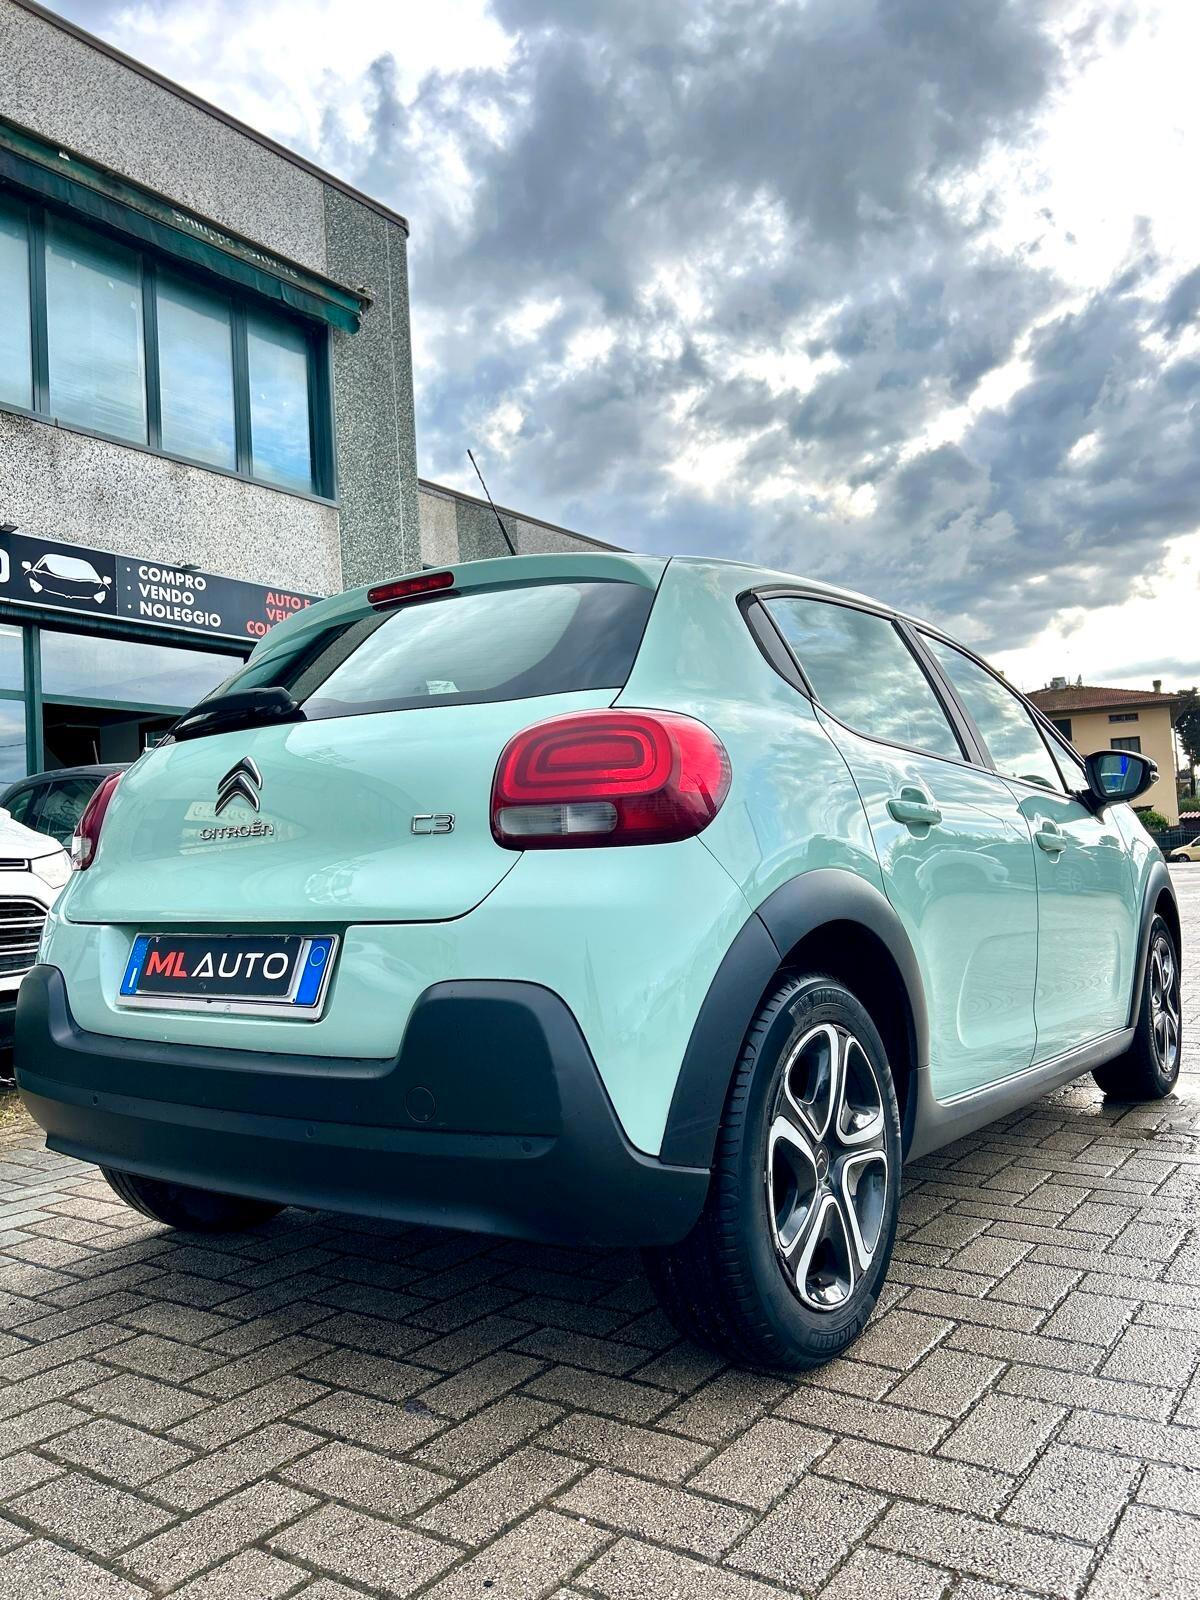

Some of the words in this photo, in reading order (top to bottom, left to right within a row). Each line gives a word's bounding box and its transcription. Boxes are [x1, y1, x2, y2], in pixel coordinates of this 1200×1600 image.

[138, 565, 206, 591] COMPRO
[139, 583, 195, 606] VENDO
[265, 591, 301, 610] AUTO
[139, 601, 221, 627] NOLEGGIO
[411, 813, 456, 835] C3
[145, 951, 188, 977] ML
[190, 952, 289, 980] AUTO
